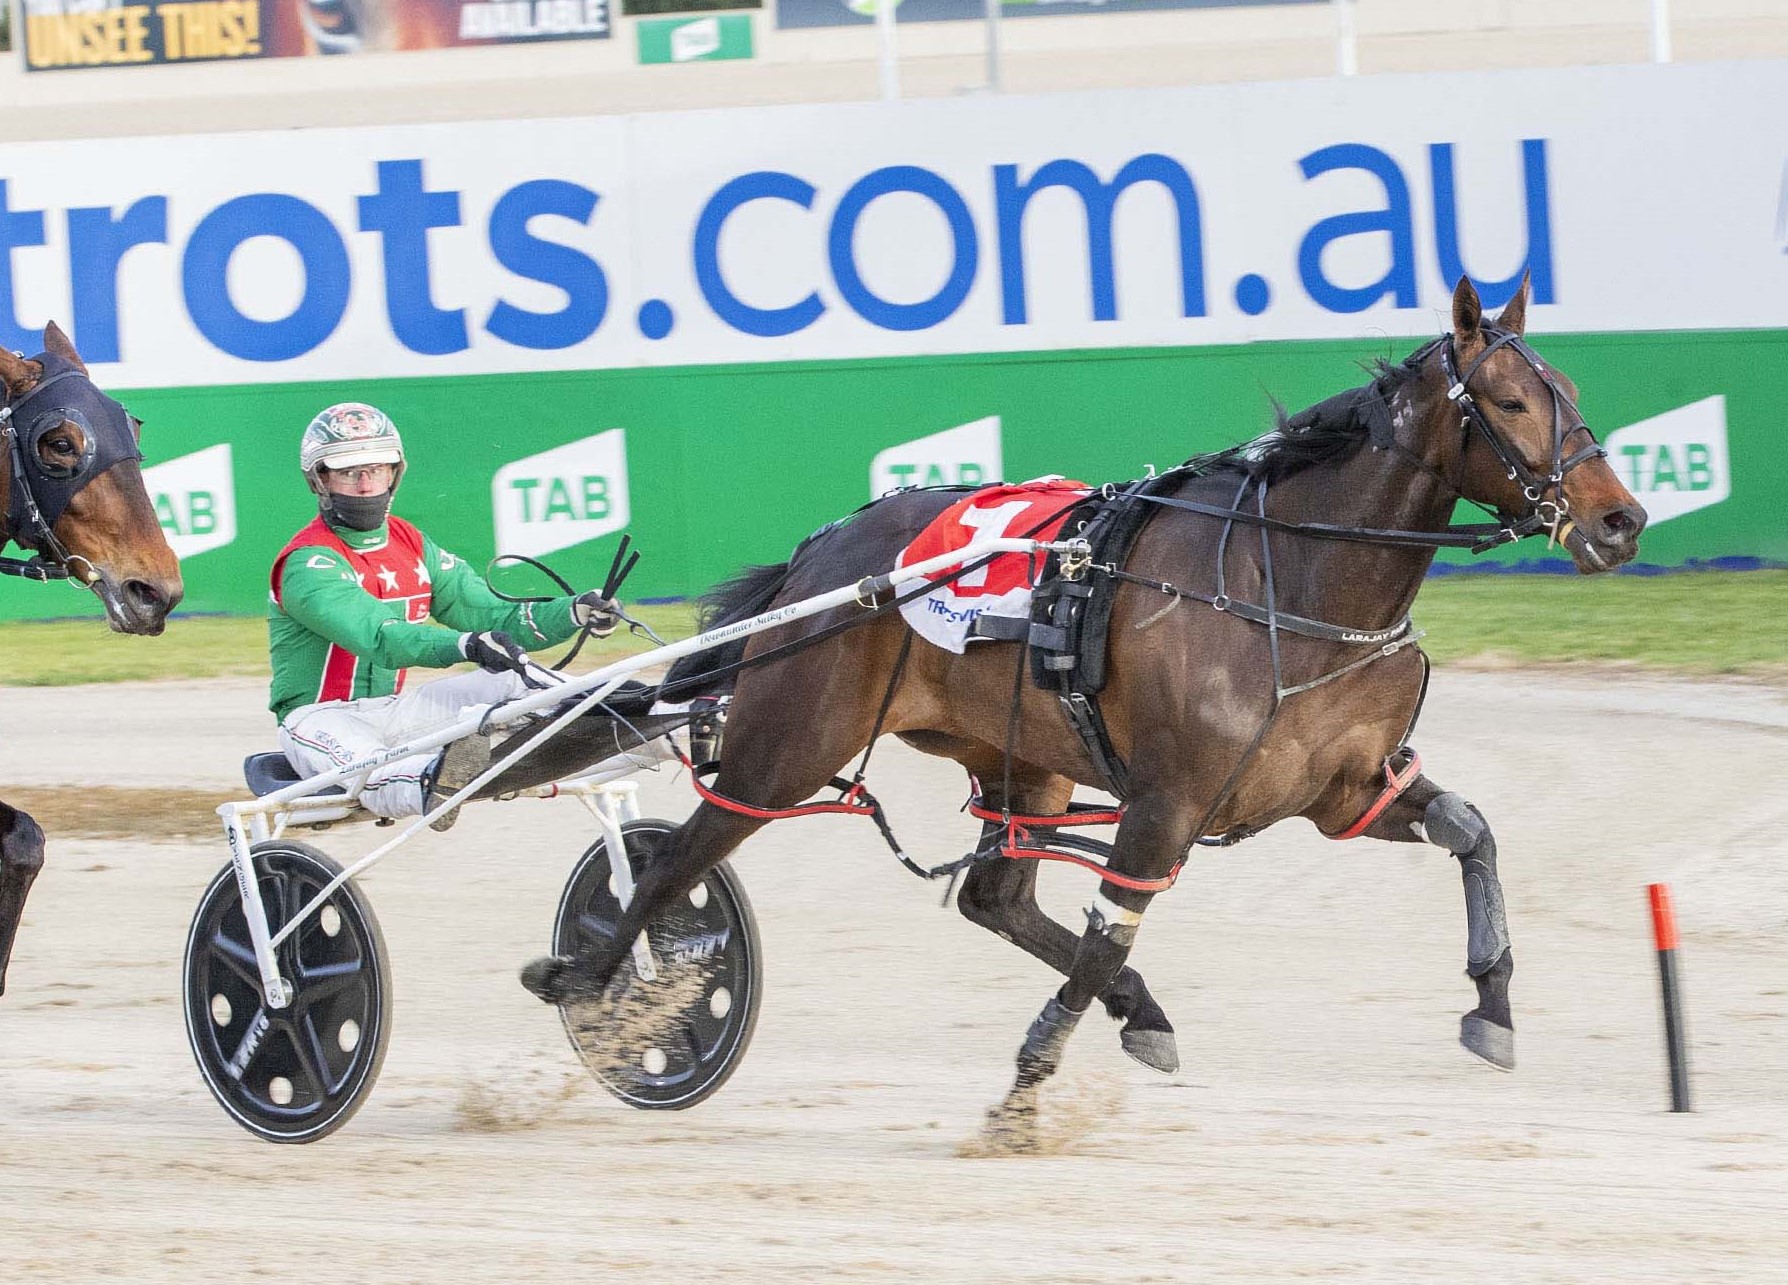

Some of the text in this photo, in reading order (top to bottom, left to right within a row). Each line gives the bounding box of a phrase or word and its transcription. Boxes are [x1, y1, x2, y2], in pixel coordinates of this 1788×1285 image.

[28, 2, 262, 67] UNSEE THIS!
[460, 0, 606, 39] AVAILABLE
[1620, 443, 1712, 492] TAB
[153, 491, 215, 536] AB
[511, 475, 611, 522] TAB
[1342, 631, 1389, 642] LARAJAY
